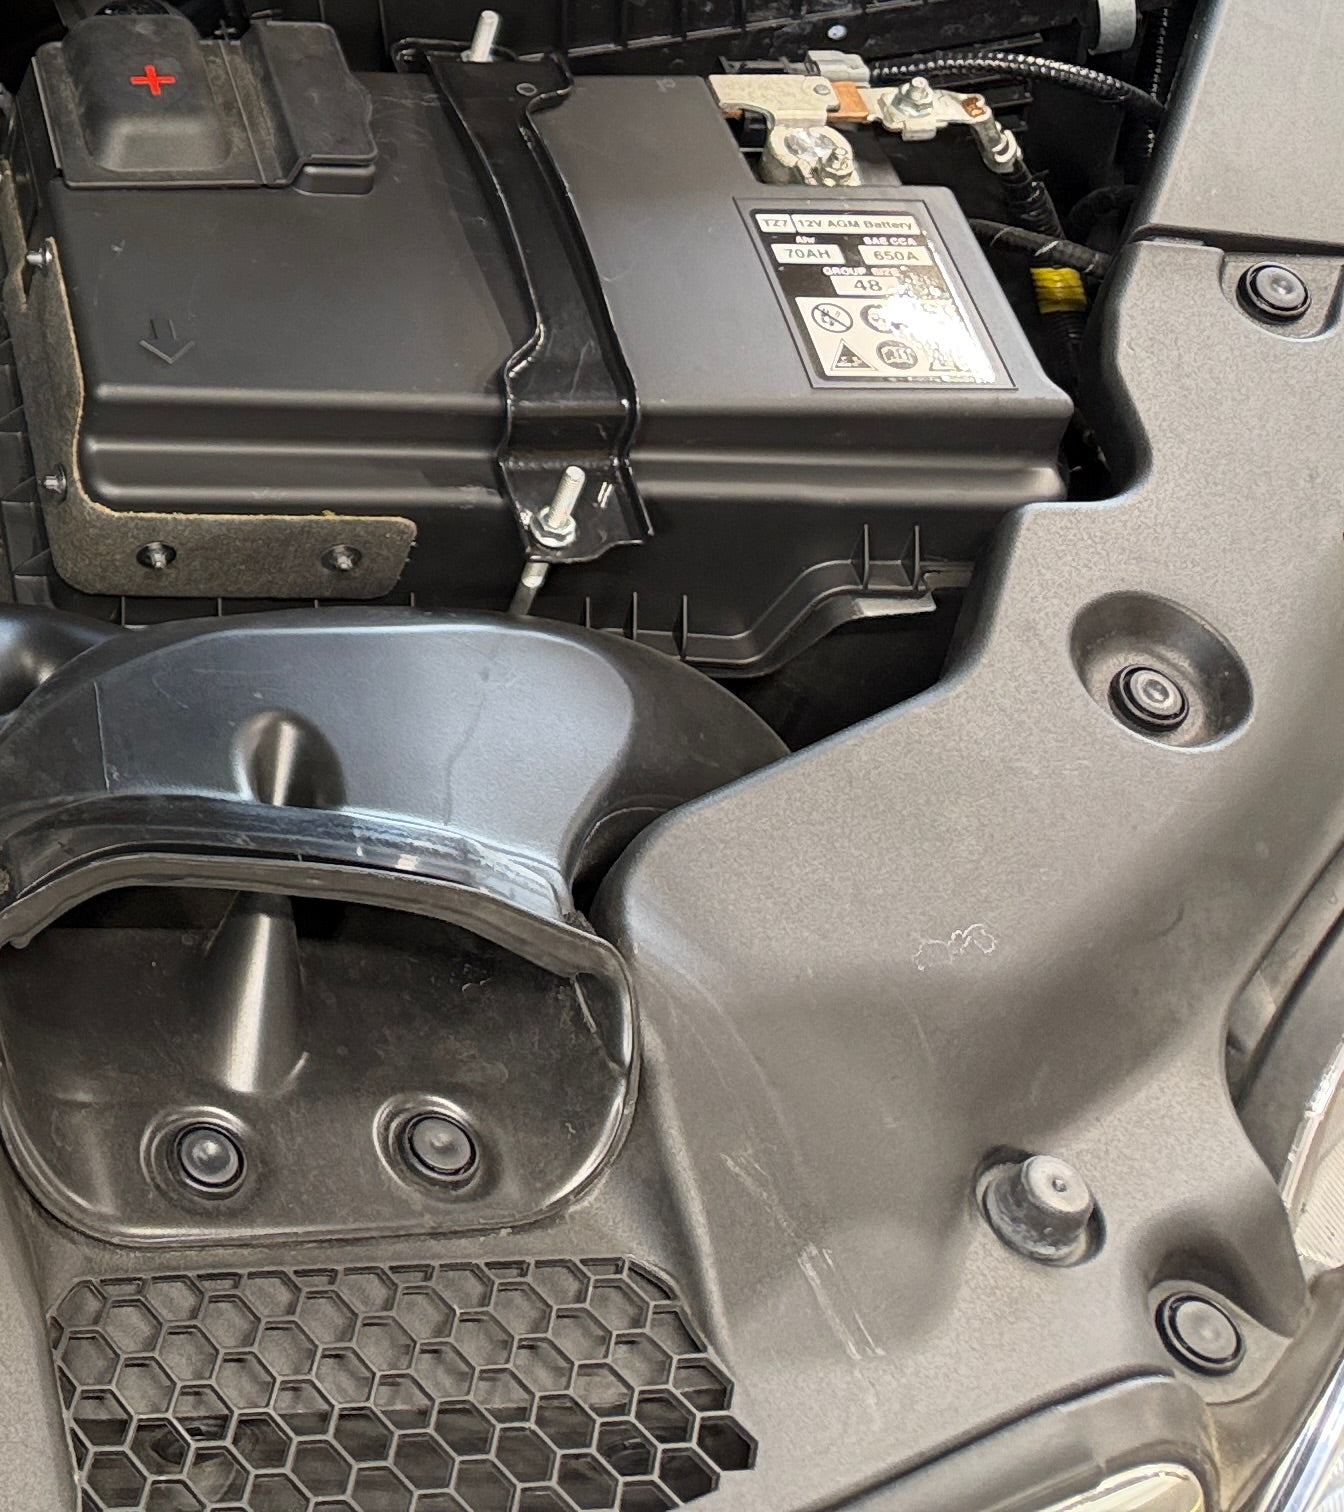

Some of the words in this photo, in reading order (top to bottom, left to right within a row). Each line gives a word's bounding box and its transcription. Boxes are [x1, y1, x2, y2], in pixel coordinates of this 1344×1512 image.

[798, 219, 822, 228] 12V
[864, 220, 912, 231] Battery
[784, 248, 832, 259] 70AH
[873, 250, 920, 261] 650A
[822, 266, 866, 276] GROUP
[854, 279, 882, 292] 48
